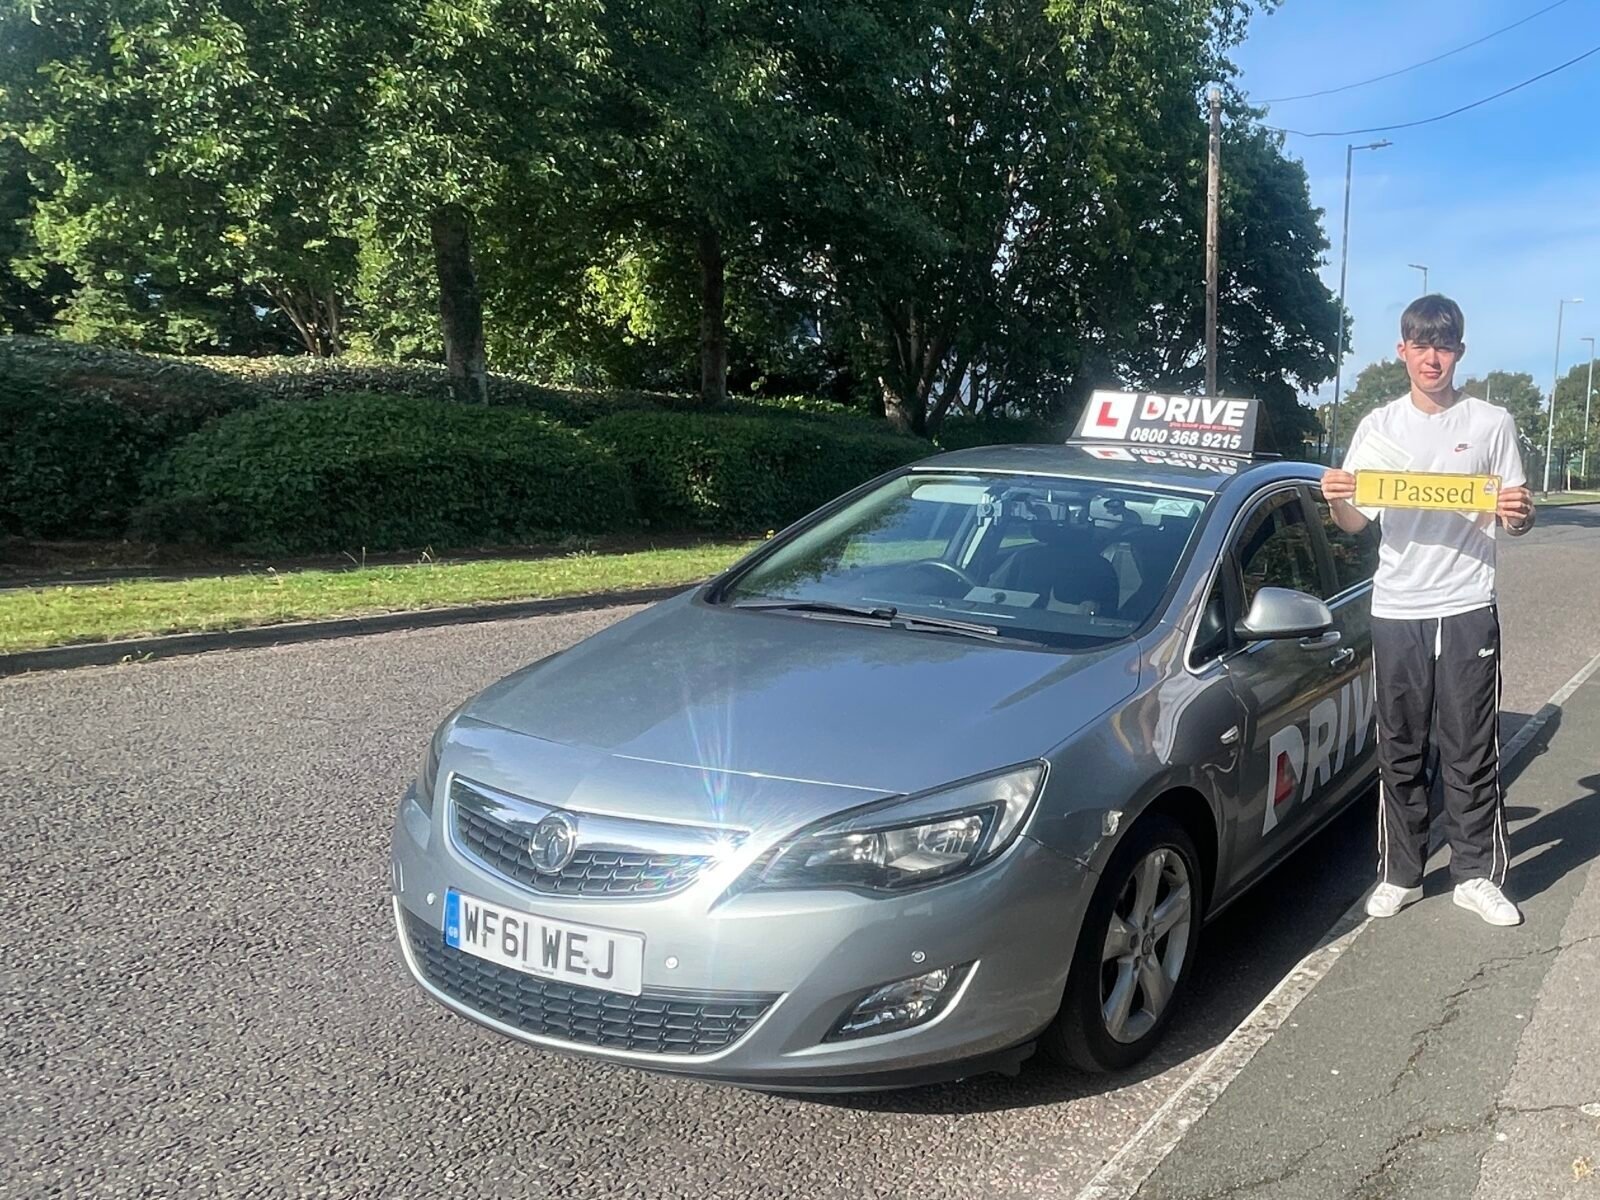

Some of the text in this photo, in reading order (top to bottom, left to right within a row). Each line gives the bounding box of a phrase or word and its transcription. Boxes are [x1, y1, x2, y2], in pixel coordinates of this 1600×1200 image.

[1096, 401, 1119, 427] L
[1140, 394, 1249, 427] DRIVE
[1130, 427, 1241, 450] 0800 368 9215
[1377, 478, 1475, 505] I Passed
[1262, 668, 1375, 836] DRIV
[464, 902, 615, 980] WF61 WEJ
